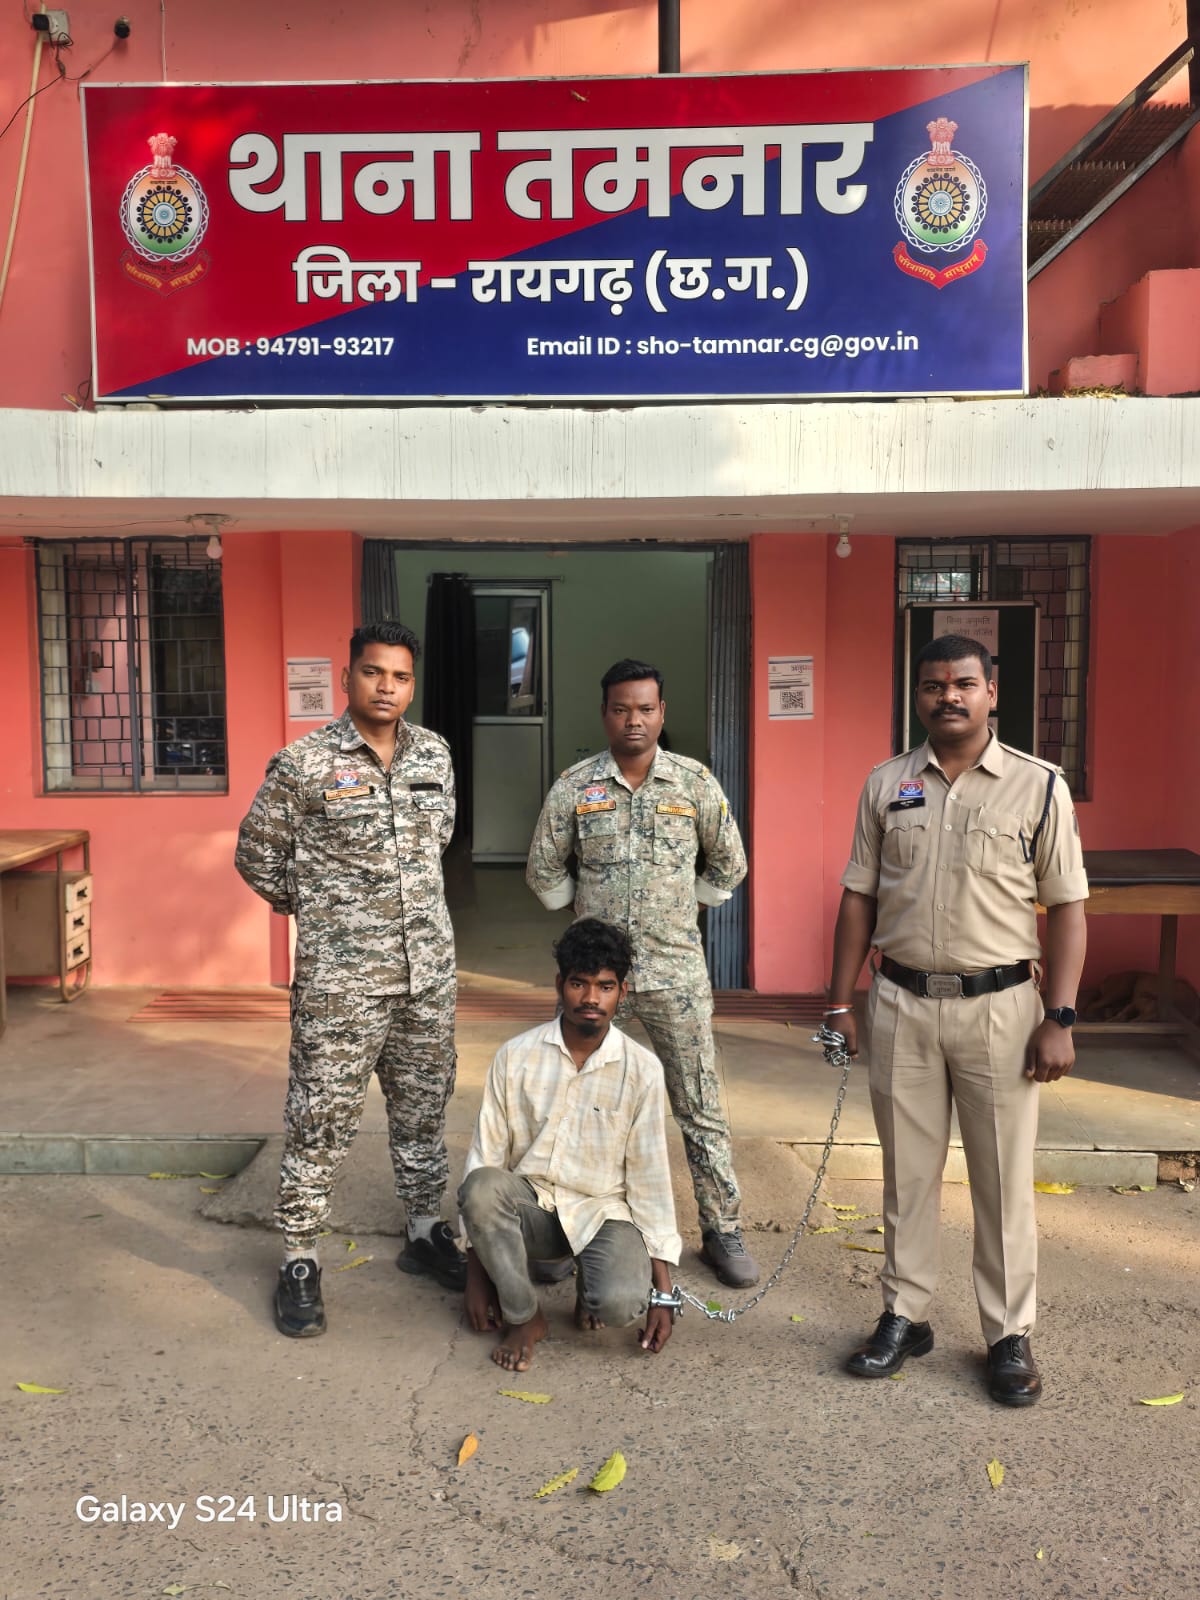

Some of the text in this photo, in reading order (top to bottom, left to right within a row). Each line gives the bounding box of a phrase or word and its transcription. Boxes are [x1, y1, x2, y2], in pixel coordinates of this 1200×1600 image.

[229, 123, 874, 221] थाना तमनार
[292, 245, 421, 303] जिला
[468, 259, 634, 316] रायगढ़
[645, 247, 809, 313] (छ.ग.)
[187, 337, 241, 356] MOB
[256, 336, 395, 356] 94791-93217
[527, 336, 592, 356] Email
[597, 337, 621, 355] ID
[636, 331, 919, 359] sho-tamnar.cg@gov.in
